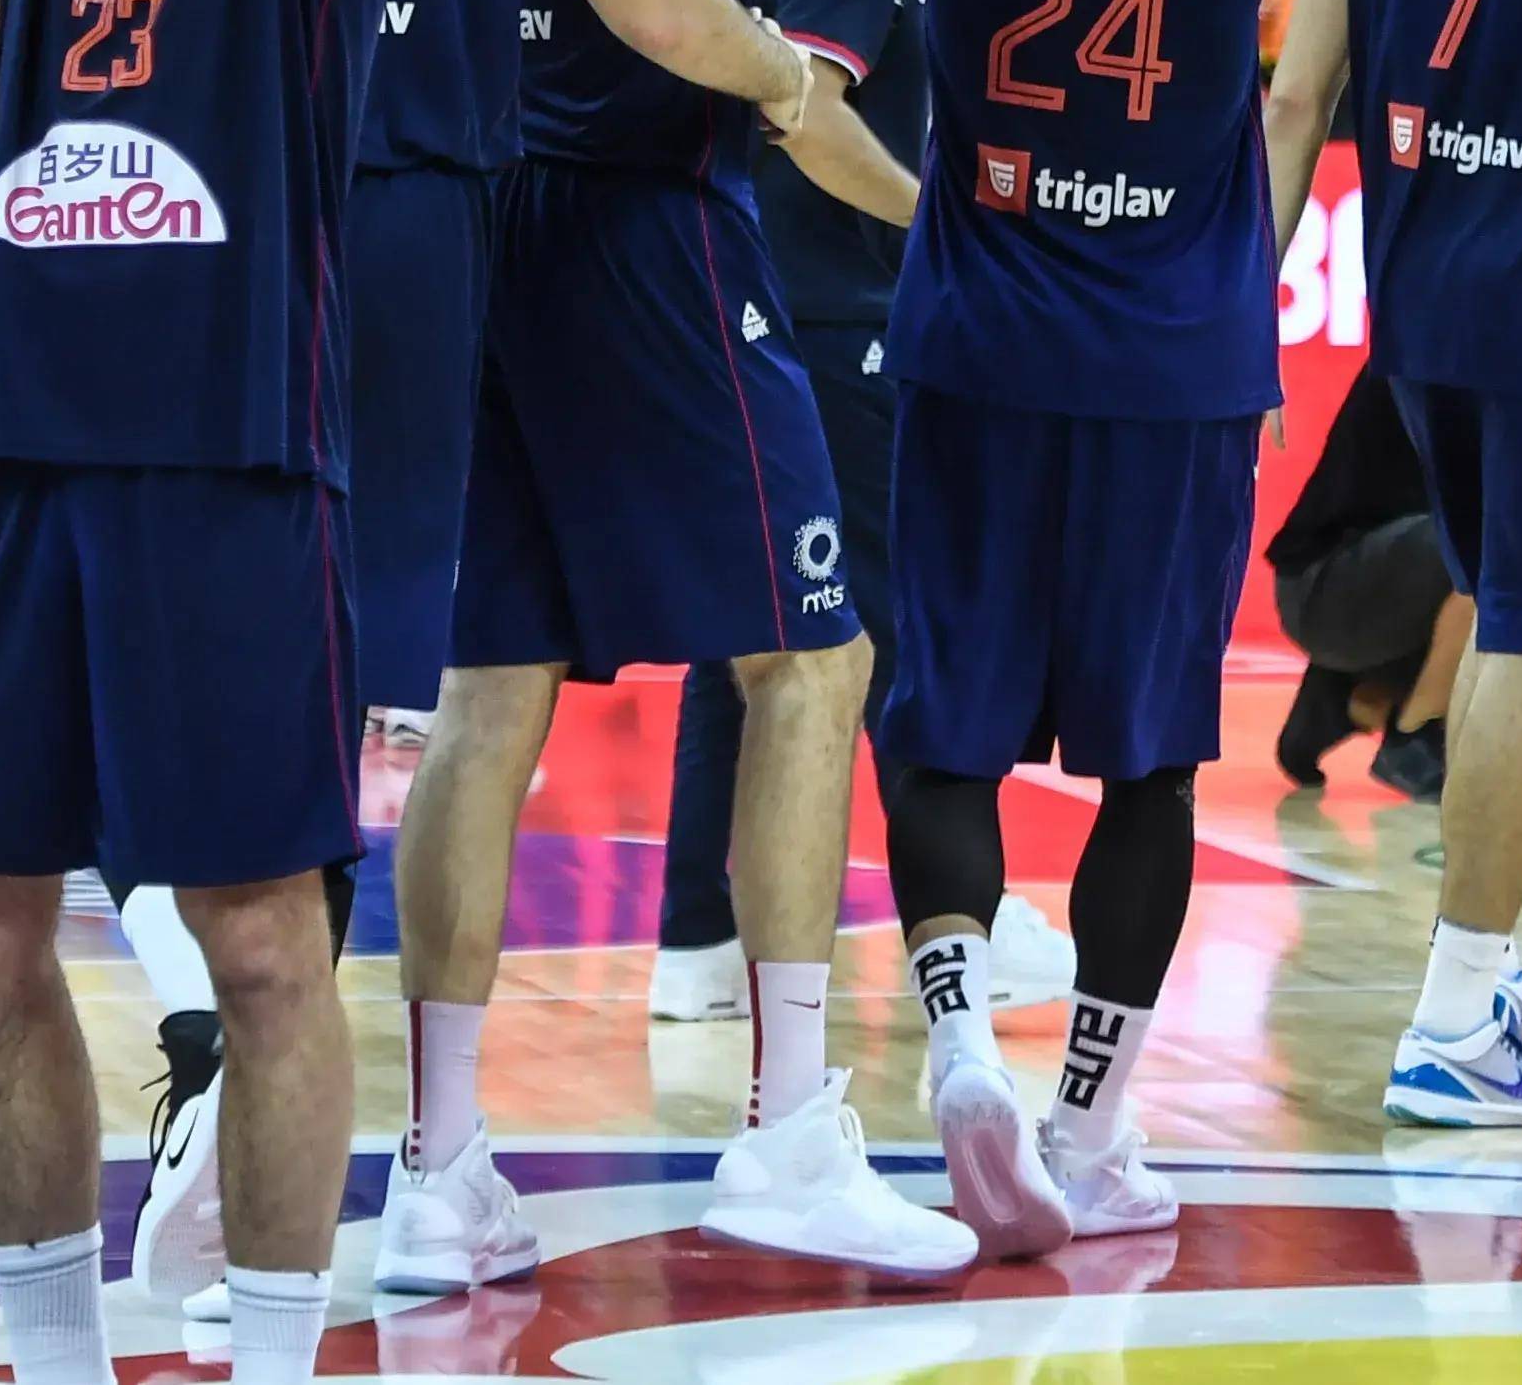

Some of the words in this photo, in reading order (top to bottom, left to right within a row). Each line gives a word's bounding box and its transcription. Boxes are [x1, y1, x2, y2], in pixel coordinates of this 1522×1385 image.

[37, 141, 154, 186] 百岁山
[1035, 165, 1177, 228] triglav
[802, 584, 845, 614] mts
